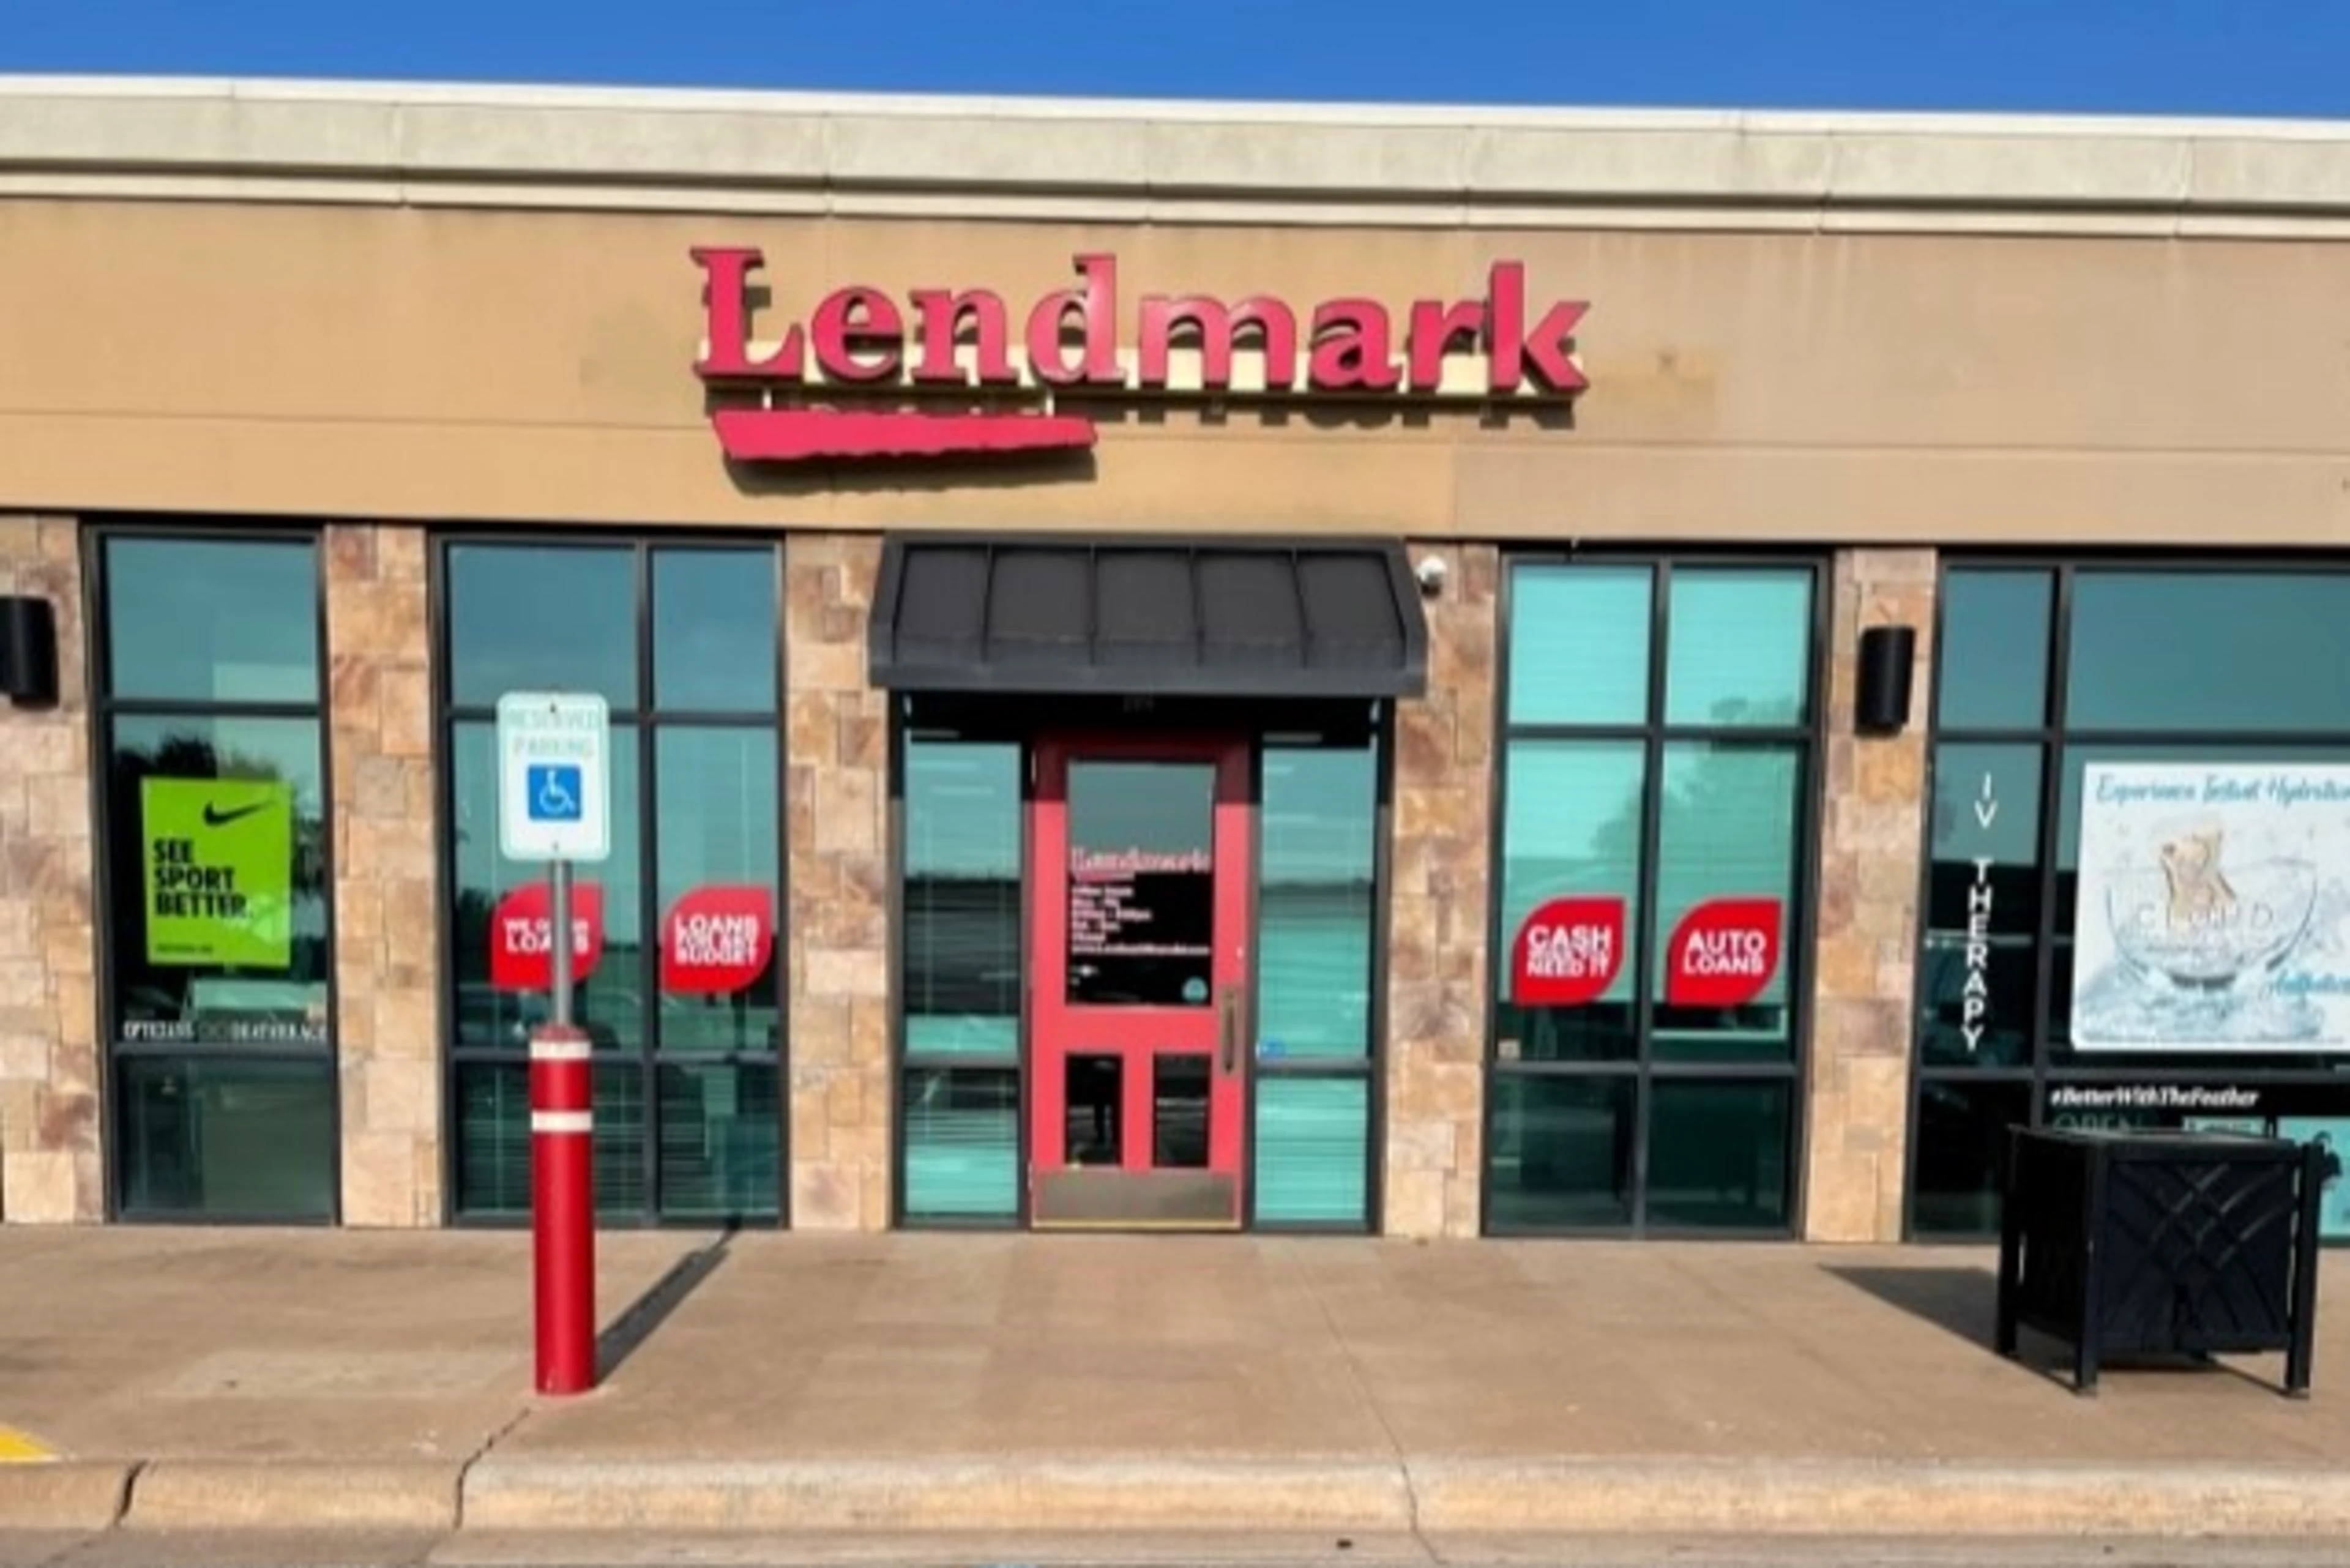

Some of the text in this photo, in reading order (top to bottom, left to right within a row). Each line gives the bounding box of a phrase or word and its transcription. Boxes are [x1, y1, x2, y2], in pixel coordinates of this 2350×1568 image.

[689, 246, 1590, 392] Lendmark
[153, 838, 193, 865] SEE
[154, 867, 236, 891] SPORT
[675, 914, 759, 936] LOANS
[1527, 925, 1613, 948] CASH
[1685, 929, 1767, 953] AUTO
[1684, 953, 1764, 974] LOANS
[1961, 857, 1993, 1052] THERAPY
